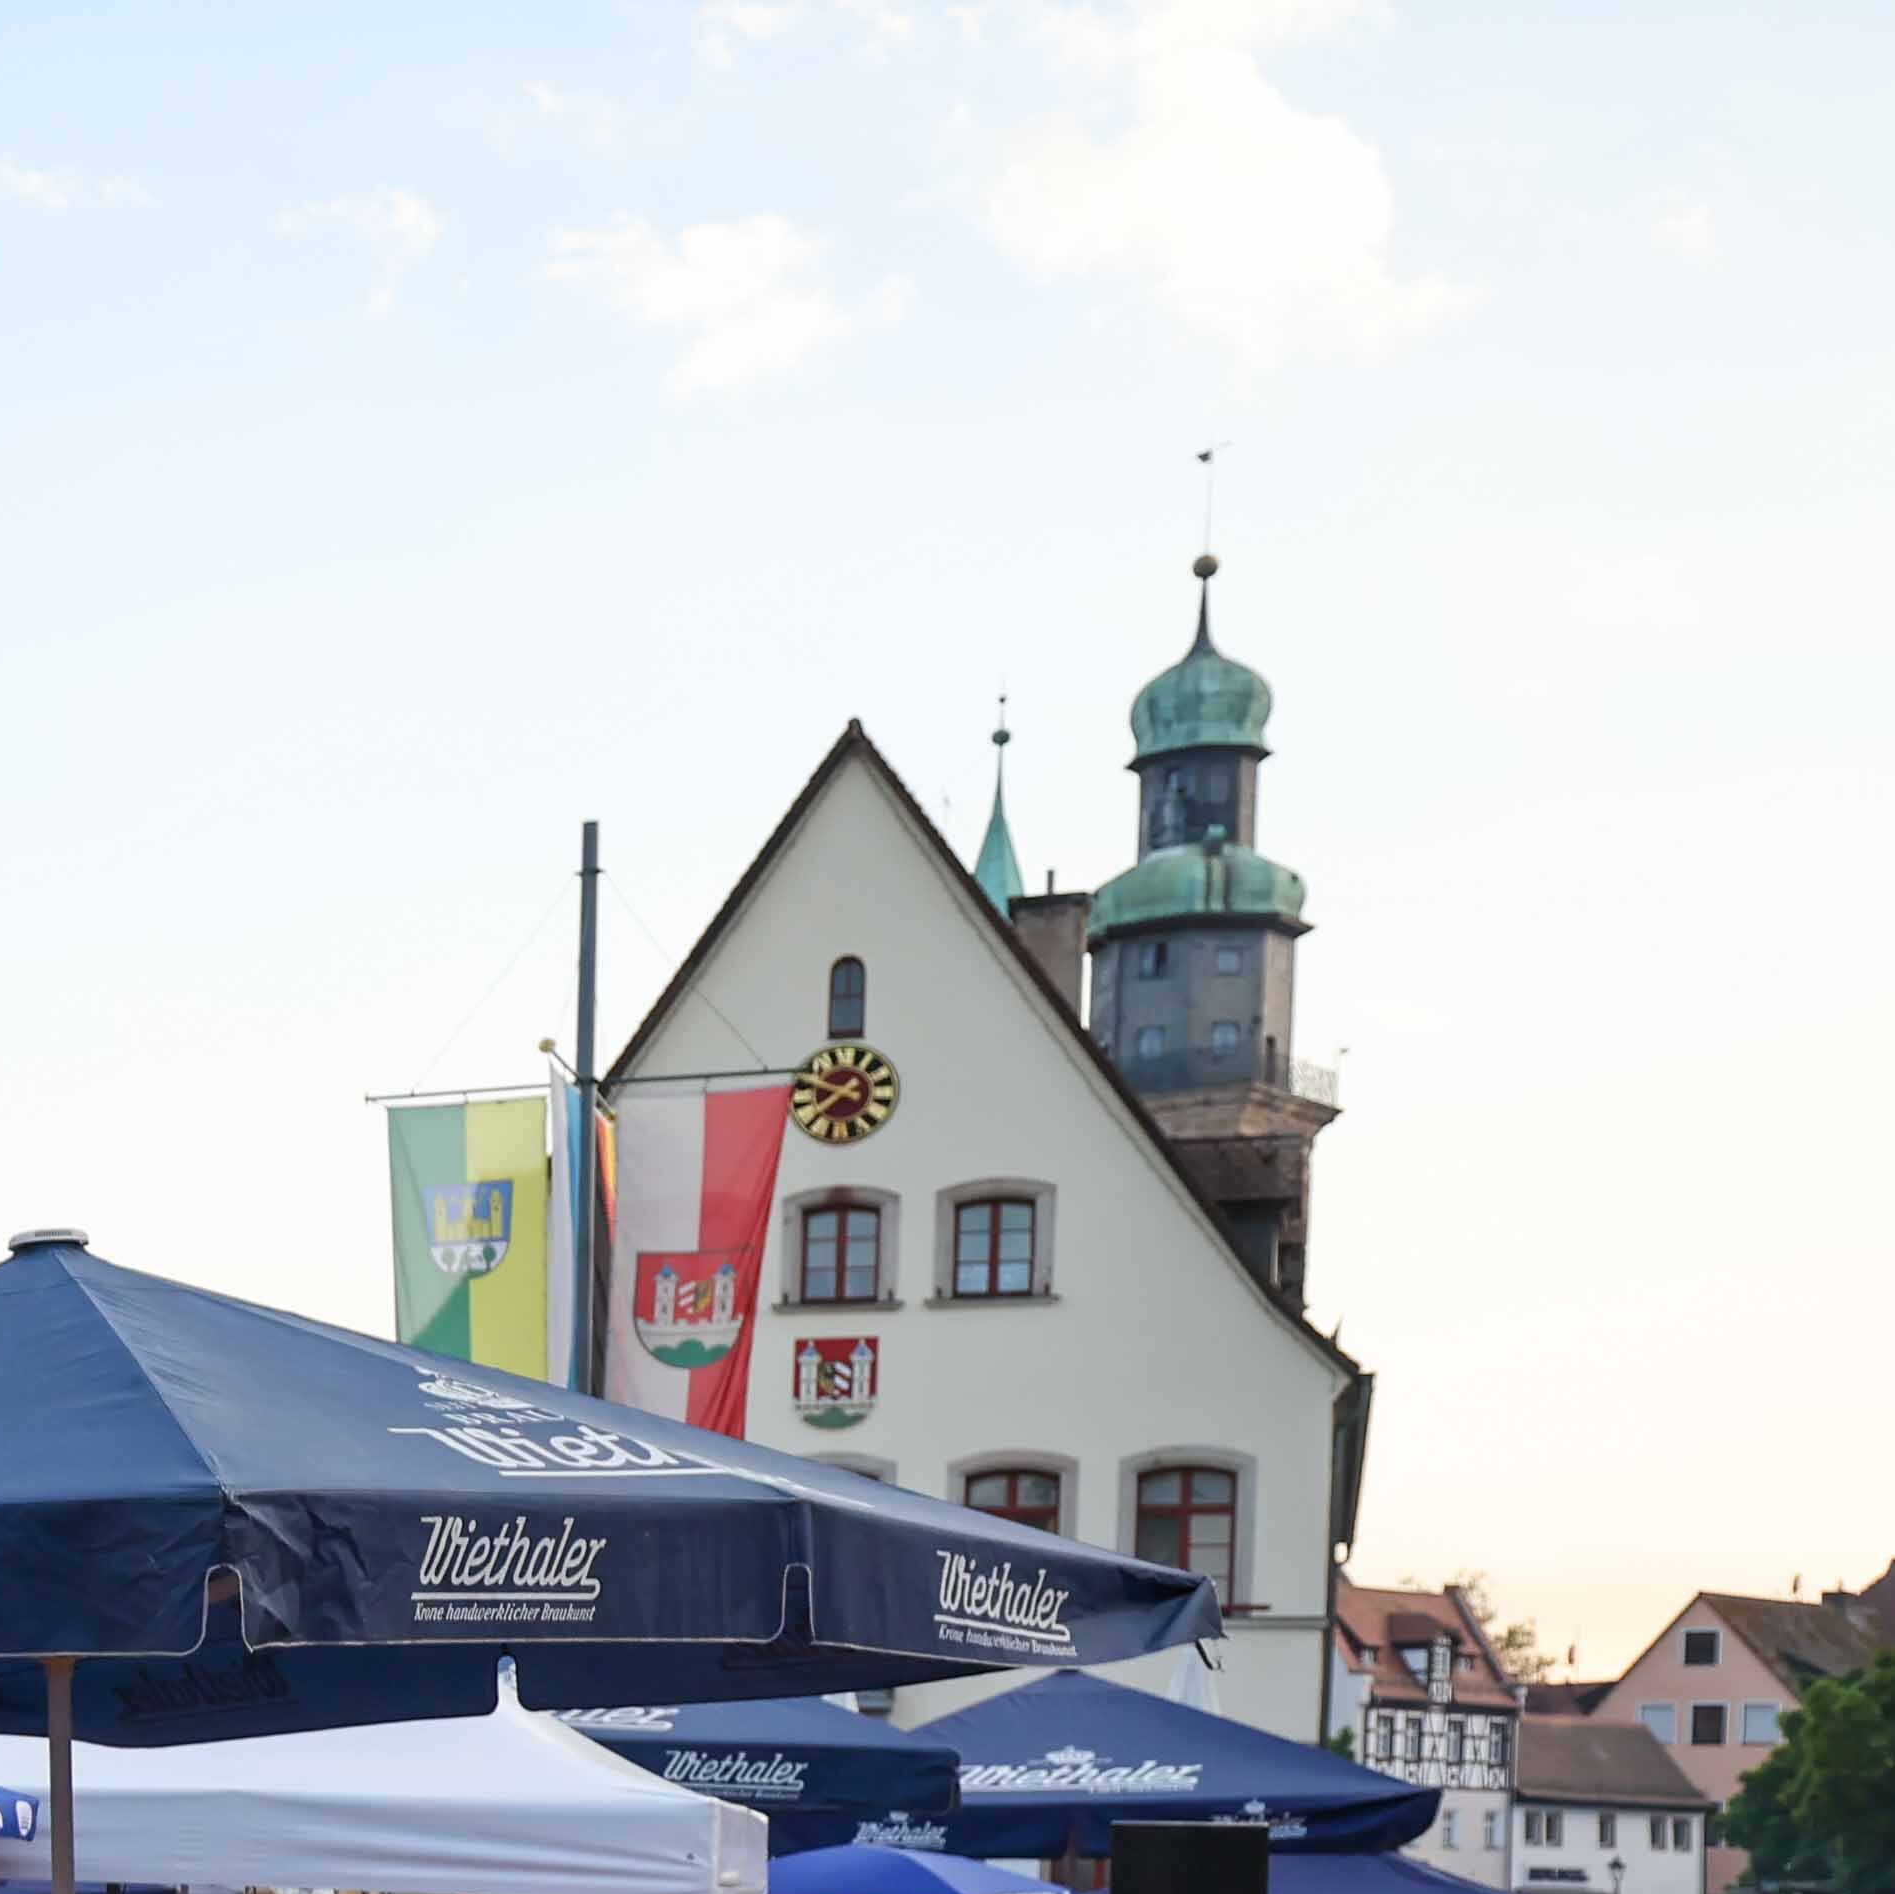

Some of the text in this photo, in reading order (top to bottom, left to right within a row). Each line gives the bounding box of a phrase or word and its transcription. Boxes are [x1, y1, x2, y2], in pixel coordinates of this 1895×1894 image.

[419, 1515, 607, 1592] Wiethaler
[414, 1602, 596, 1621] Krone handwerklicher Braukunst
[936, 1549, 1071, 1634] Wiethaler
[664, 1750, 809, 1787] Wiethaler
